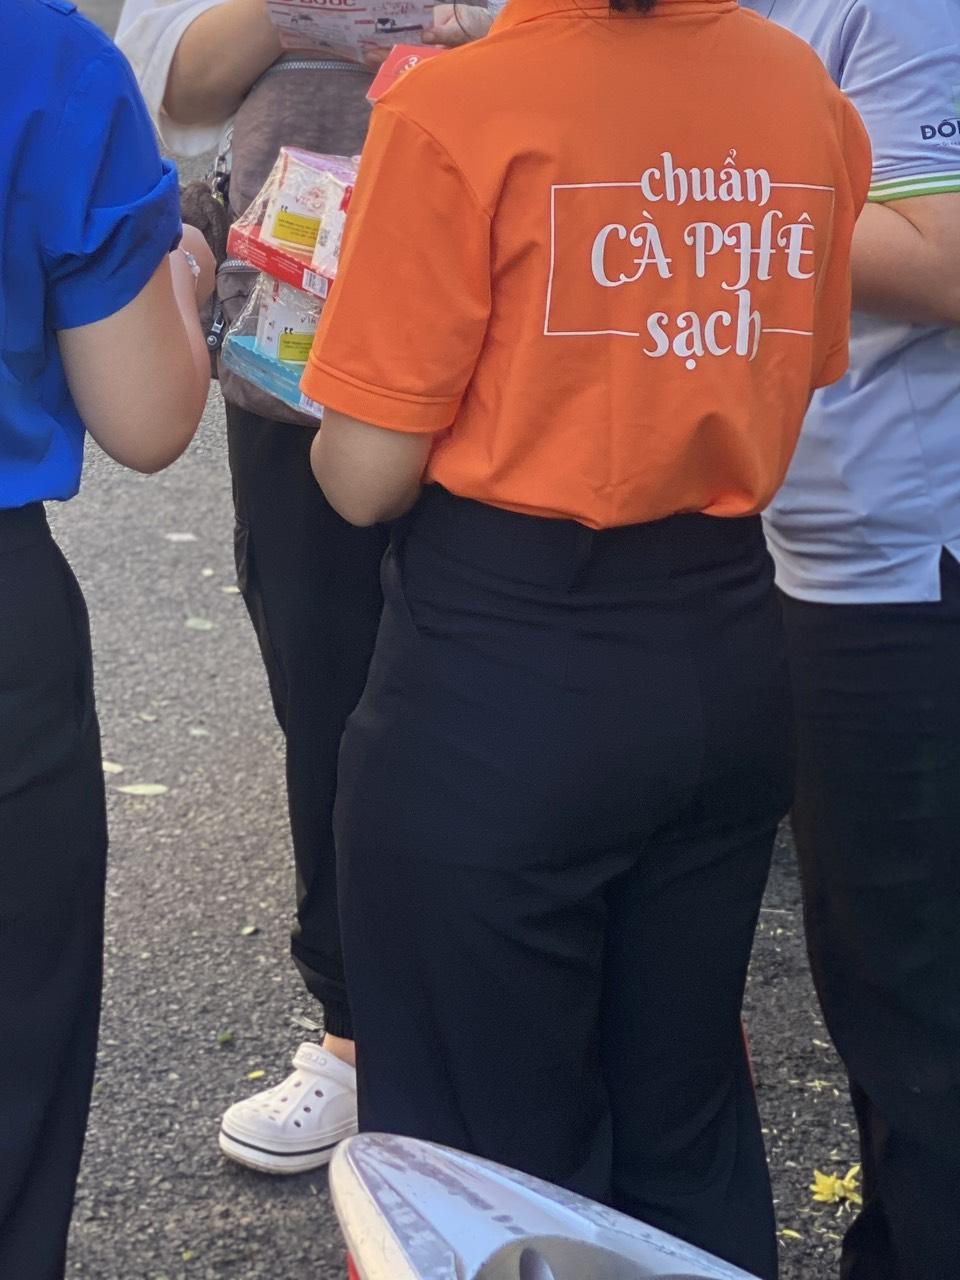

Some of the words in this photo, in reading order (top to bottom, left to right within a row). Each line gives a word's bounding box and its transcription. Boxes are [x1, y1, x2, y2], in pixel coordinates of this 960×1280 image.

[641, 148, 771, 206] chuẩn
[591, 210, 673, 288] CÀ
[684, 209, 816, 290] PHÊ
[643, 289, 762, 370] sạch
